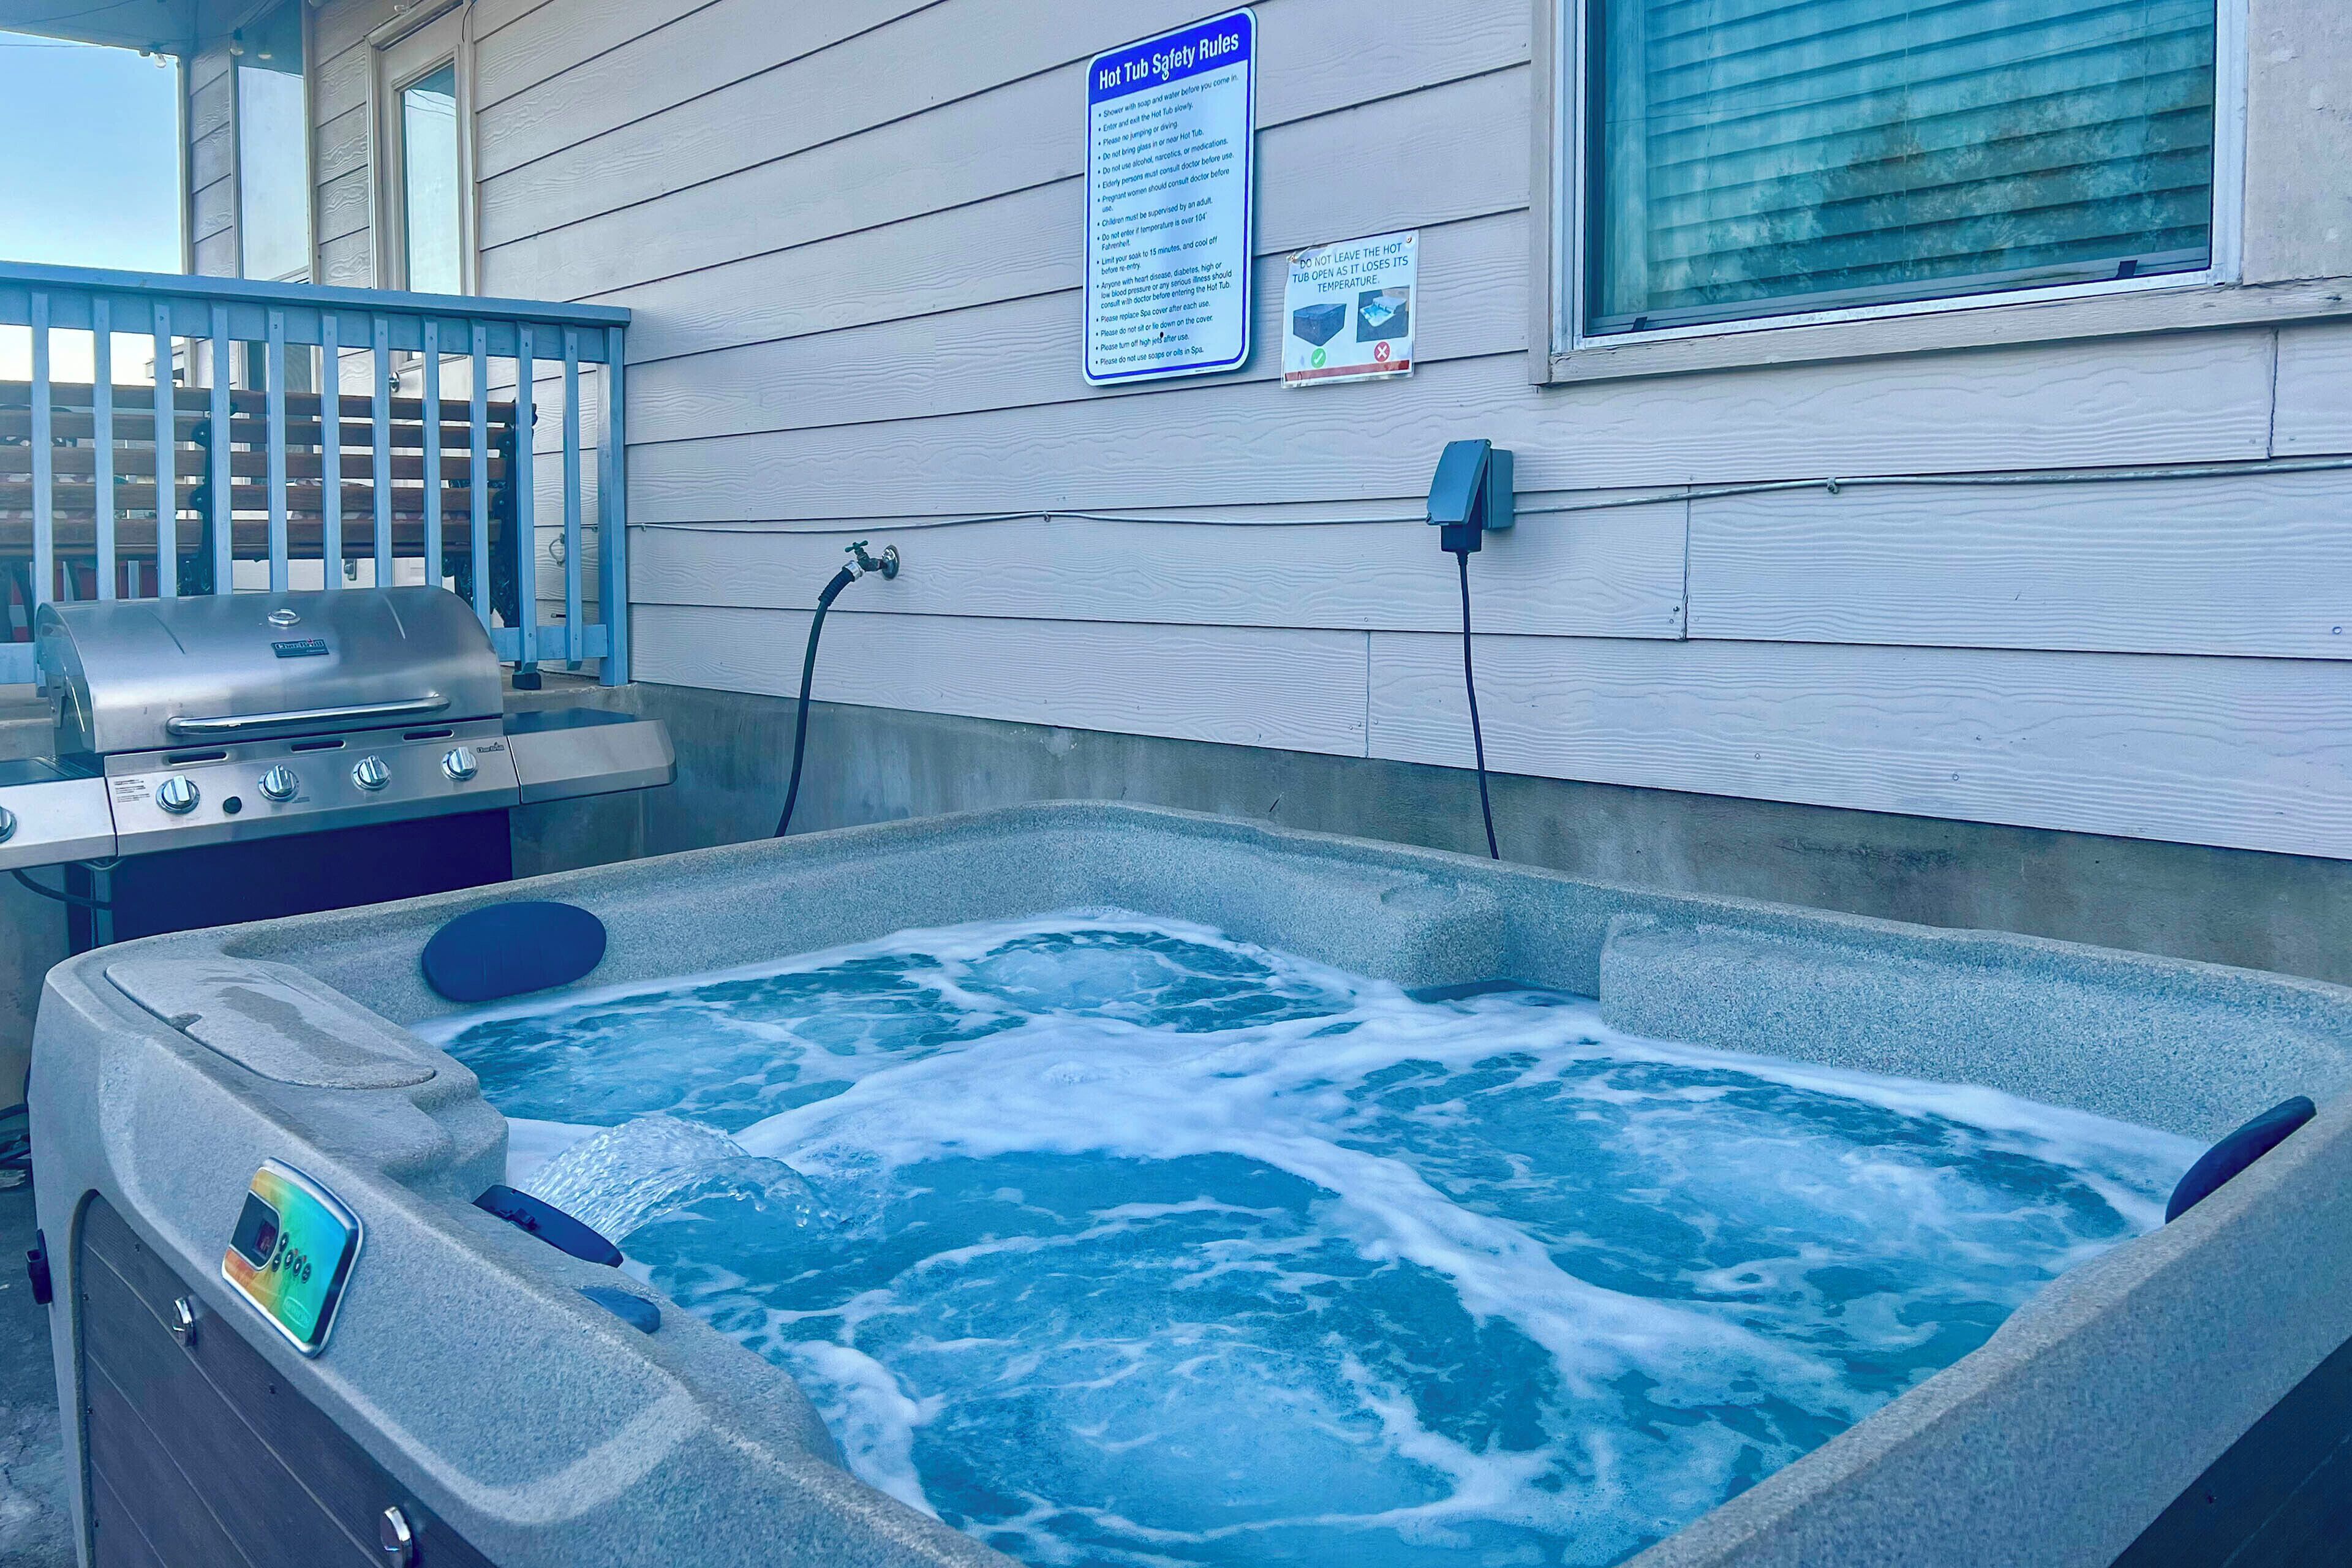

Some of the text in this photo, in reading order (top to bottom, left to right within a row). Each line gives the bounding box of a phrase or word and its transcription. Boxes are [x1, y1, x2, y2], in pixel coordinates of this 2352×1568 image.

[1099, 33, 1239, 90] Hot Tub Safety Rules
[1103, 106, 1123, 117] Shower
[1125, 102, 1136, 111] with
[1137, 99, 1151, 108] soap
[1152, 94, 1163, 104] and
[1164, 90, 1180, 100] water
[1181, 85, 1199, 96] before
[1200, 81, 1212, 92] you
[1213, 76, 1229, 87] come
[1103, 123, 1117, 132] Enter
[1118, 118, 1128, 127] and
[1129, 115, 1139, 124] exit
[1141, 113, 1150, 121] the
[1151, 109, 1161, 119] Hot
[1163, 106, 1173, 115] Tub
[1102, 135, 1120, 146] Please
[1129, 127, 1152, 141] jumping
[1102, 152, 1110, 160] Do
[1112, 149, 1120, 158] not
[1121, 146, 1136, 156] bring
[1137, 142, 1151, 153] glass
[1166, 135, 1178, 144] near
[1180, 131, 1190, 140] Hot
[1191, 128, 1204, 137] Tub.
[1102, 166, 1110, 175] Do
[1111, 163, 1120, 172] not
[1132, 155, 1153, 167] alcohol,
[1155, 149, 1182, 161] narcotics,
[1191, 138, 1228, 153] medications.
[1102, 152, 1234, 189] Elderly persons must consult doctor before use.
[1102, 168, 1229, 203] Pregnant women should consult doctor before
[1101, 216, 1124, 227] Children
[1125, 213, 1138, 222] must
[1147, 203, 1178, 217] supervised
[1179, 202, 1186, 212] by
[1196, 197, 1212, 207] adult.
[1101, 233, 1109, 241] Do
[1110, 230, 1119, 239] not
[1120, 228, 1134, 238] enter
[1140, 221, 1174, 233] temperature
[1181, 216, 1194, 225] over
[1101, 238, 1130, 251] Fahrenheit.
[1101, 256, 1114, 265] Limit
[1115, 254, 1127, 264] your
[1128, 251, 1141, 260] soak
[1157, 244, 1181, 254] minutes,
[1182, 239, 1194, 249] and
[1194, 237, 1207, 247] cool
[1208, 235, 1217, 245] off
[1300, 243, 1403, 270] DO NOT LEAVE THE HOT
[1101, 262, 1140, 274] before re-entry.
[1101, 280, 1121, 290] Anyone
[1121, 276, 1133, 285] with
[1134, 274, 1148, 283] heart
[1149, 271, 1172, 281] disease,
[1174, 266, 1199, 276] diabetes,
[1200, 262, 1213, 273] high
[1293, 255, 1409, 283] TUB OPEN AS IT LOSES ITS
[1101, 299, 1120, 309] consult
[1133, 295, 1152, 304] doctor
[1152, 292, 1170, 300] before
[1171, 287, 1194, 297] entering
[1196, 285, 1205, 293] the
[1206, 282, 1217, 292] Hot
[1218, 280, 1231, 289] Tub.
[1111, 287, 1126, 297] blood
[1128, 285, 1151, 296] pressure
[1170, 277, 1191, 287] serious
[1192, 274, 1210, 283] illness
[1212, 269, 1232, 281] should
[1317, 274, 1380, 293] TEMPERATURE.
[1119, 311, 1139, 321] replace
[1140, 309, 1151, 317] Spa
[1152, 306, 1168, 315] cover
[1169, 304, 1182, 312] after
[1183, 301, 1197, 310] each
[1139, 337, 1151, 347] high
[1152, 335, 1162, 345] jets
[1163, 334, 1177, 343] after
[1173, 347, 1183, 356] oils
[1191, 345, 1204, 355] Spa.
